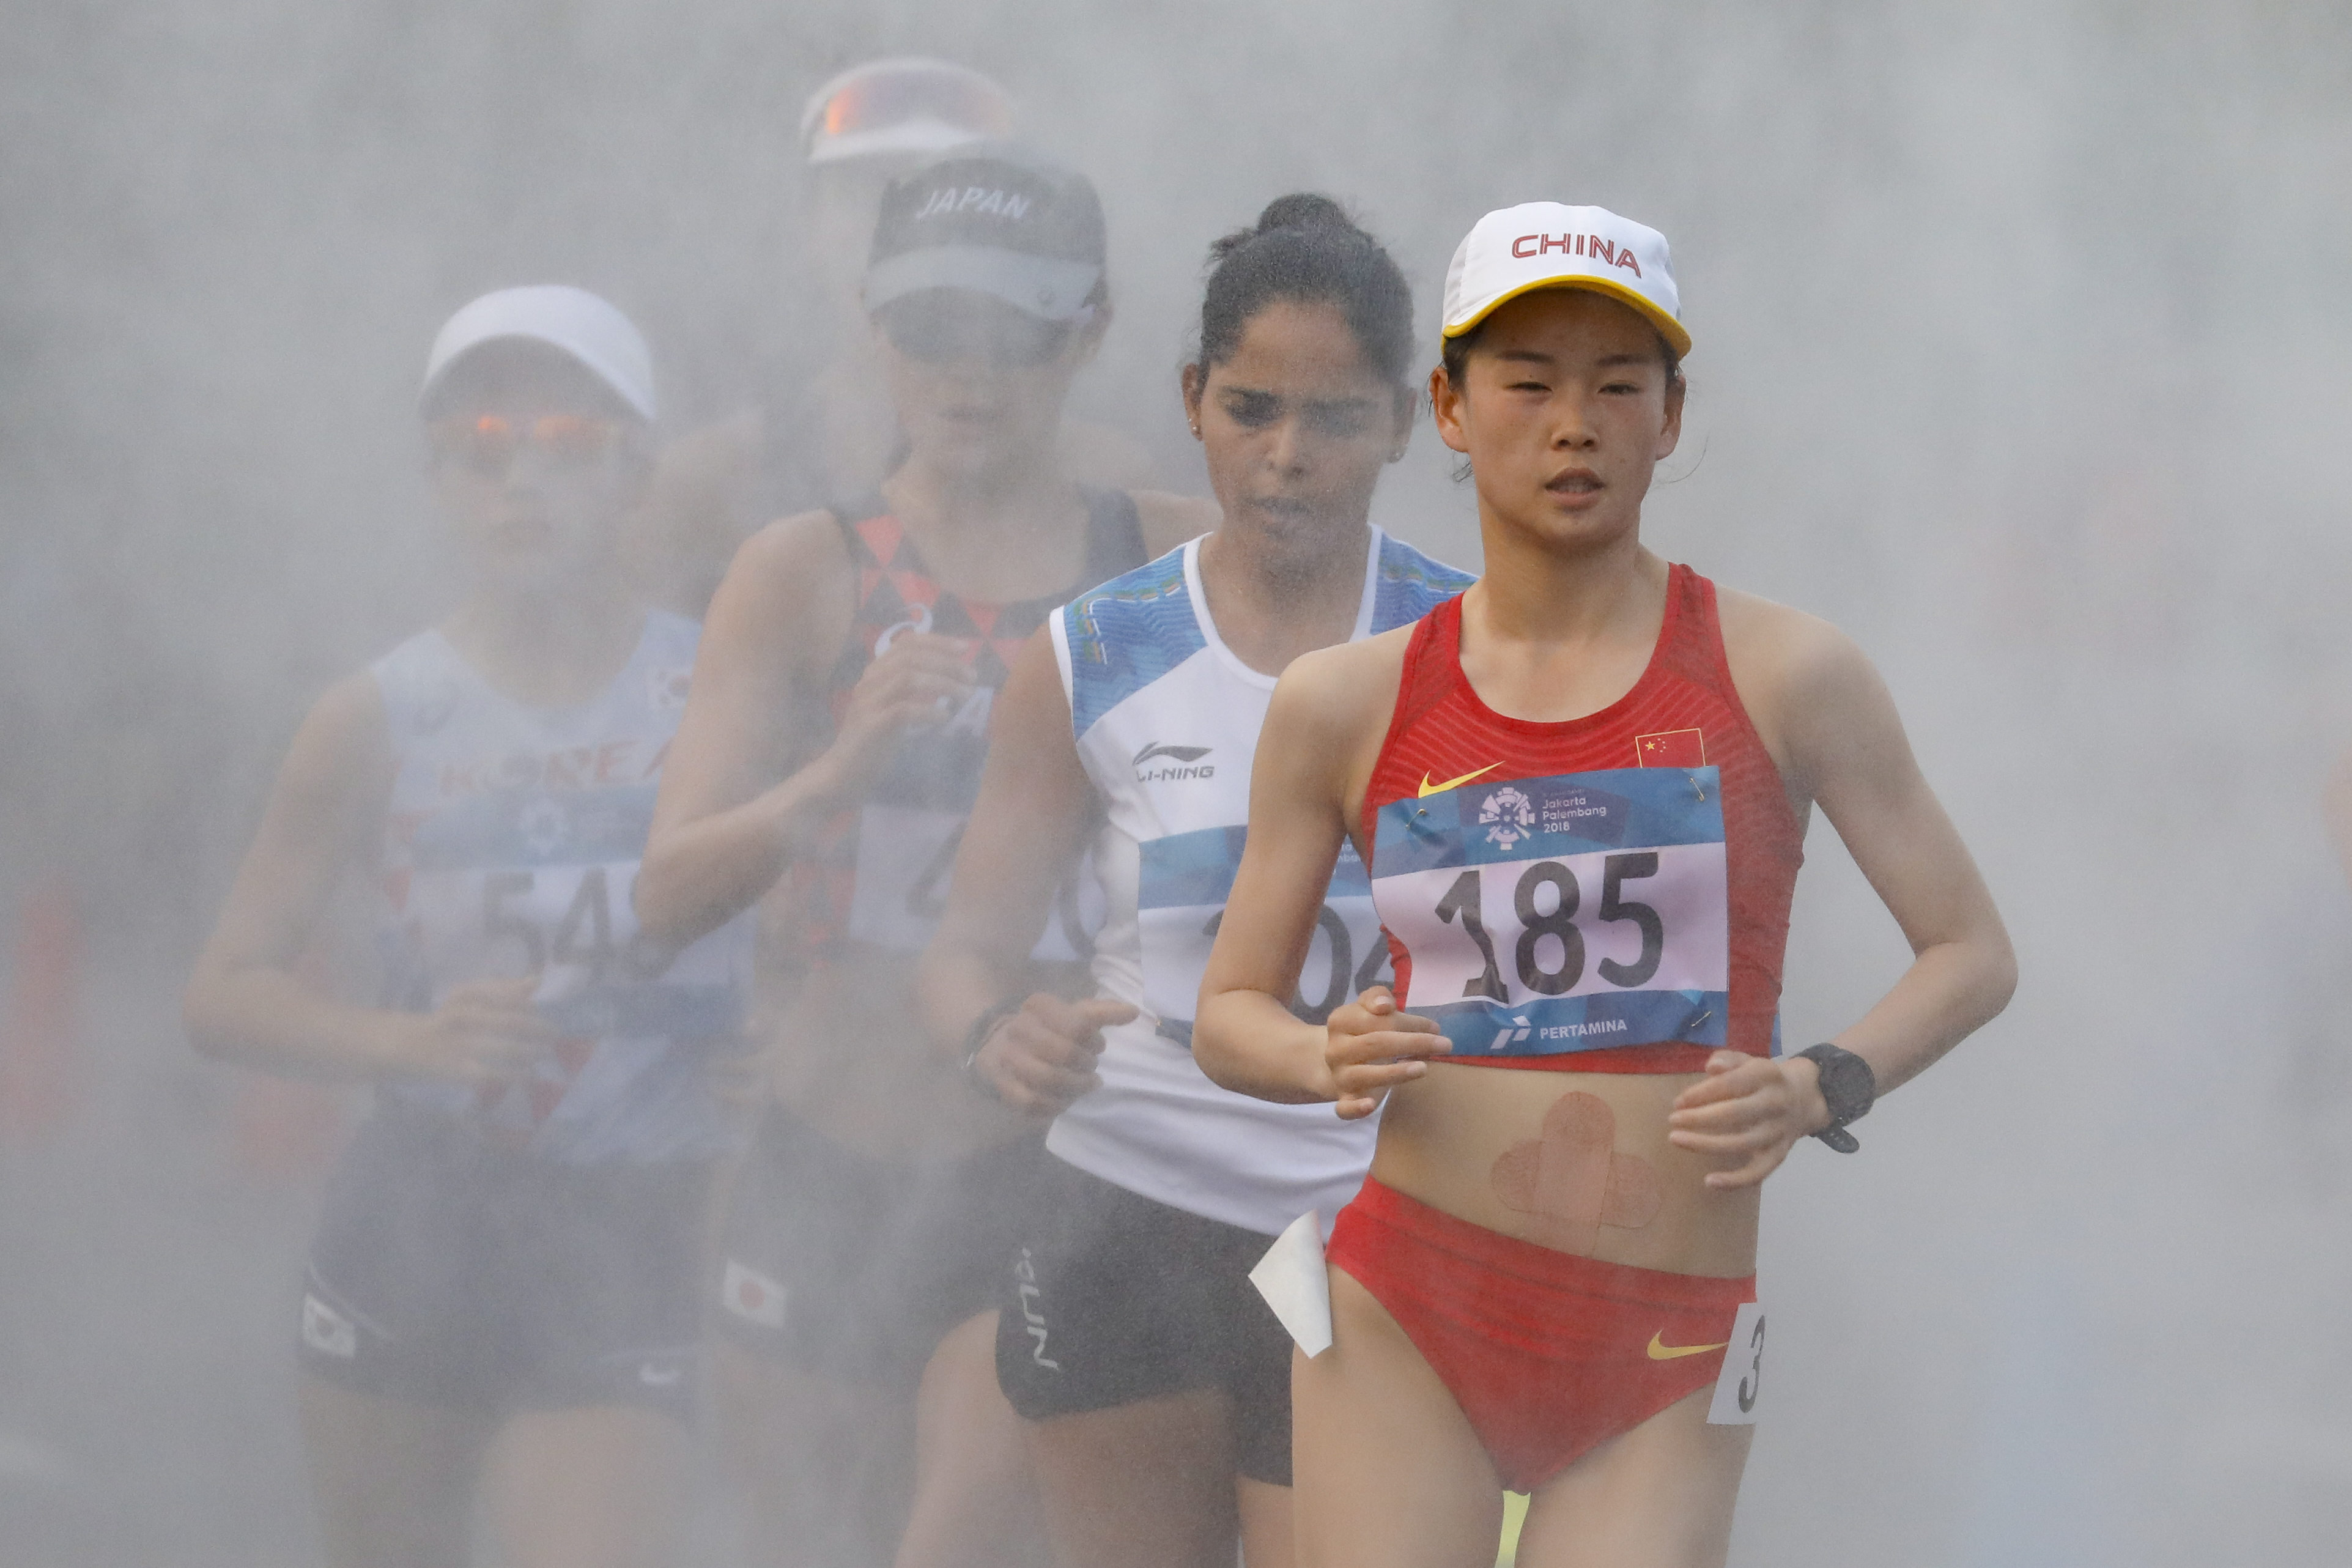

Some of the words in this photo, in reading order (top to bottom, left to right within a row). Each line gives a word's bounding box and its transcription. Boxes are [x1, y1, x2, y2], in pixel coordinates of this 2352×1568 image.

[917, 186, 1032, 219] JAPAN
[1512, 232, 1642, 279] CHINA
[1136, 765, 1215, 783] LI-NING
[1542, 796, 1586, 809] Jakarta
[1542, 807, 1607, 821] Palembang
[1543, 821, 1570, 834] 2018
[1435, 851, 1663, 1004] 185
[1540, 1018, 1627, 1040] PERTAMINA
[1738, 1315, 1766, 1413] 3
